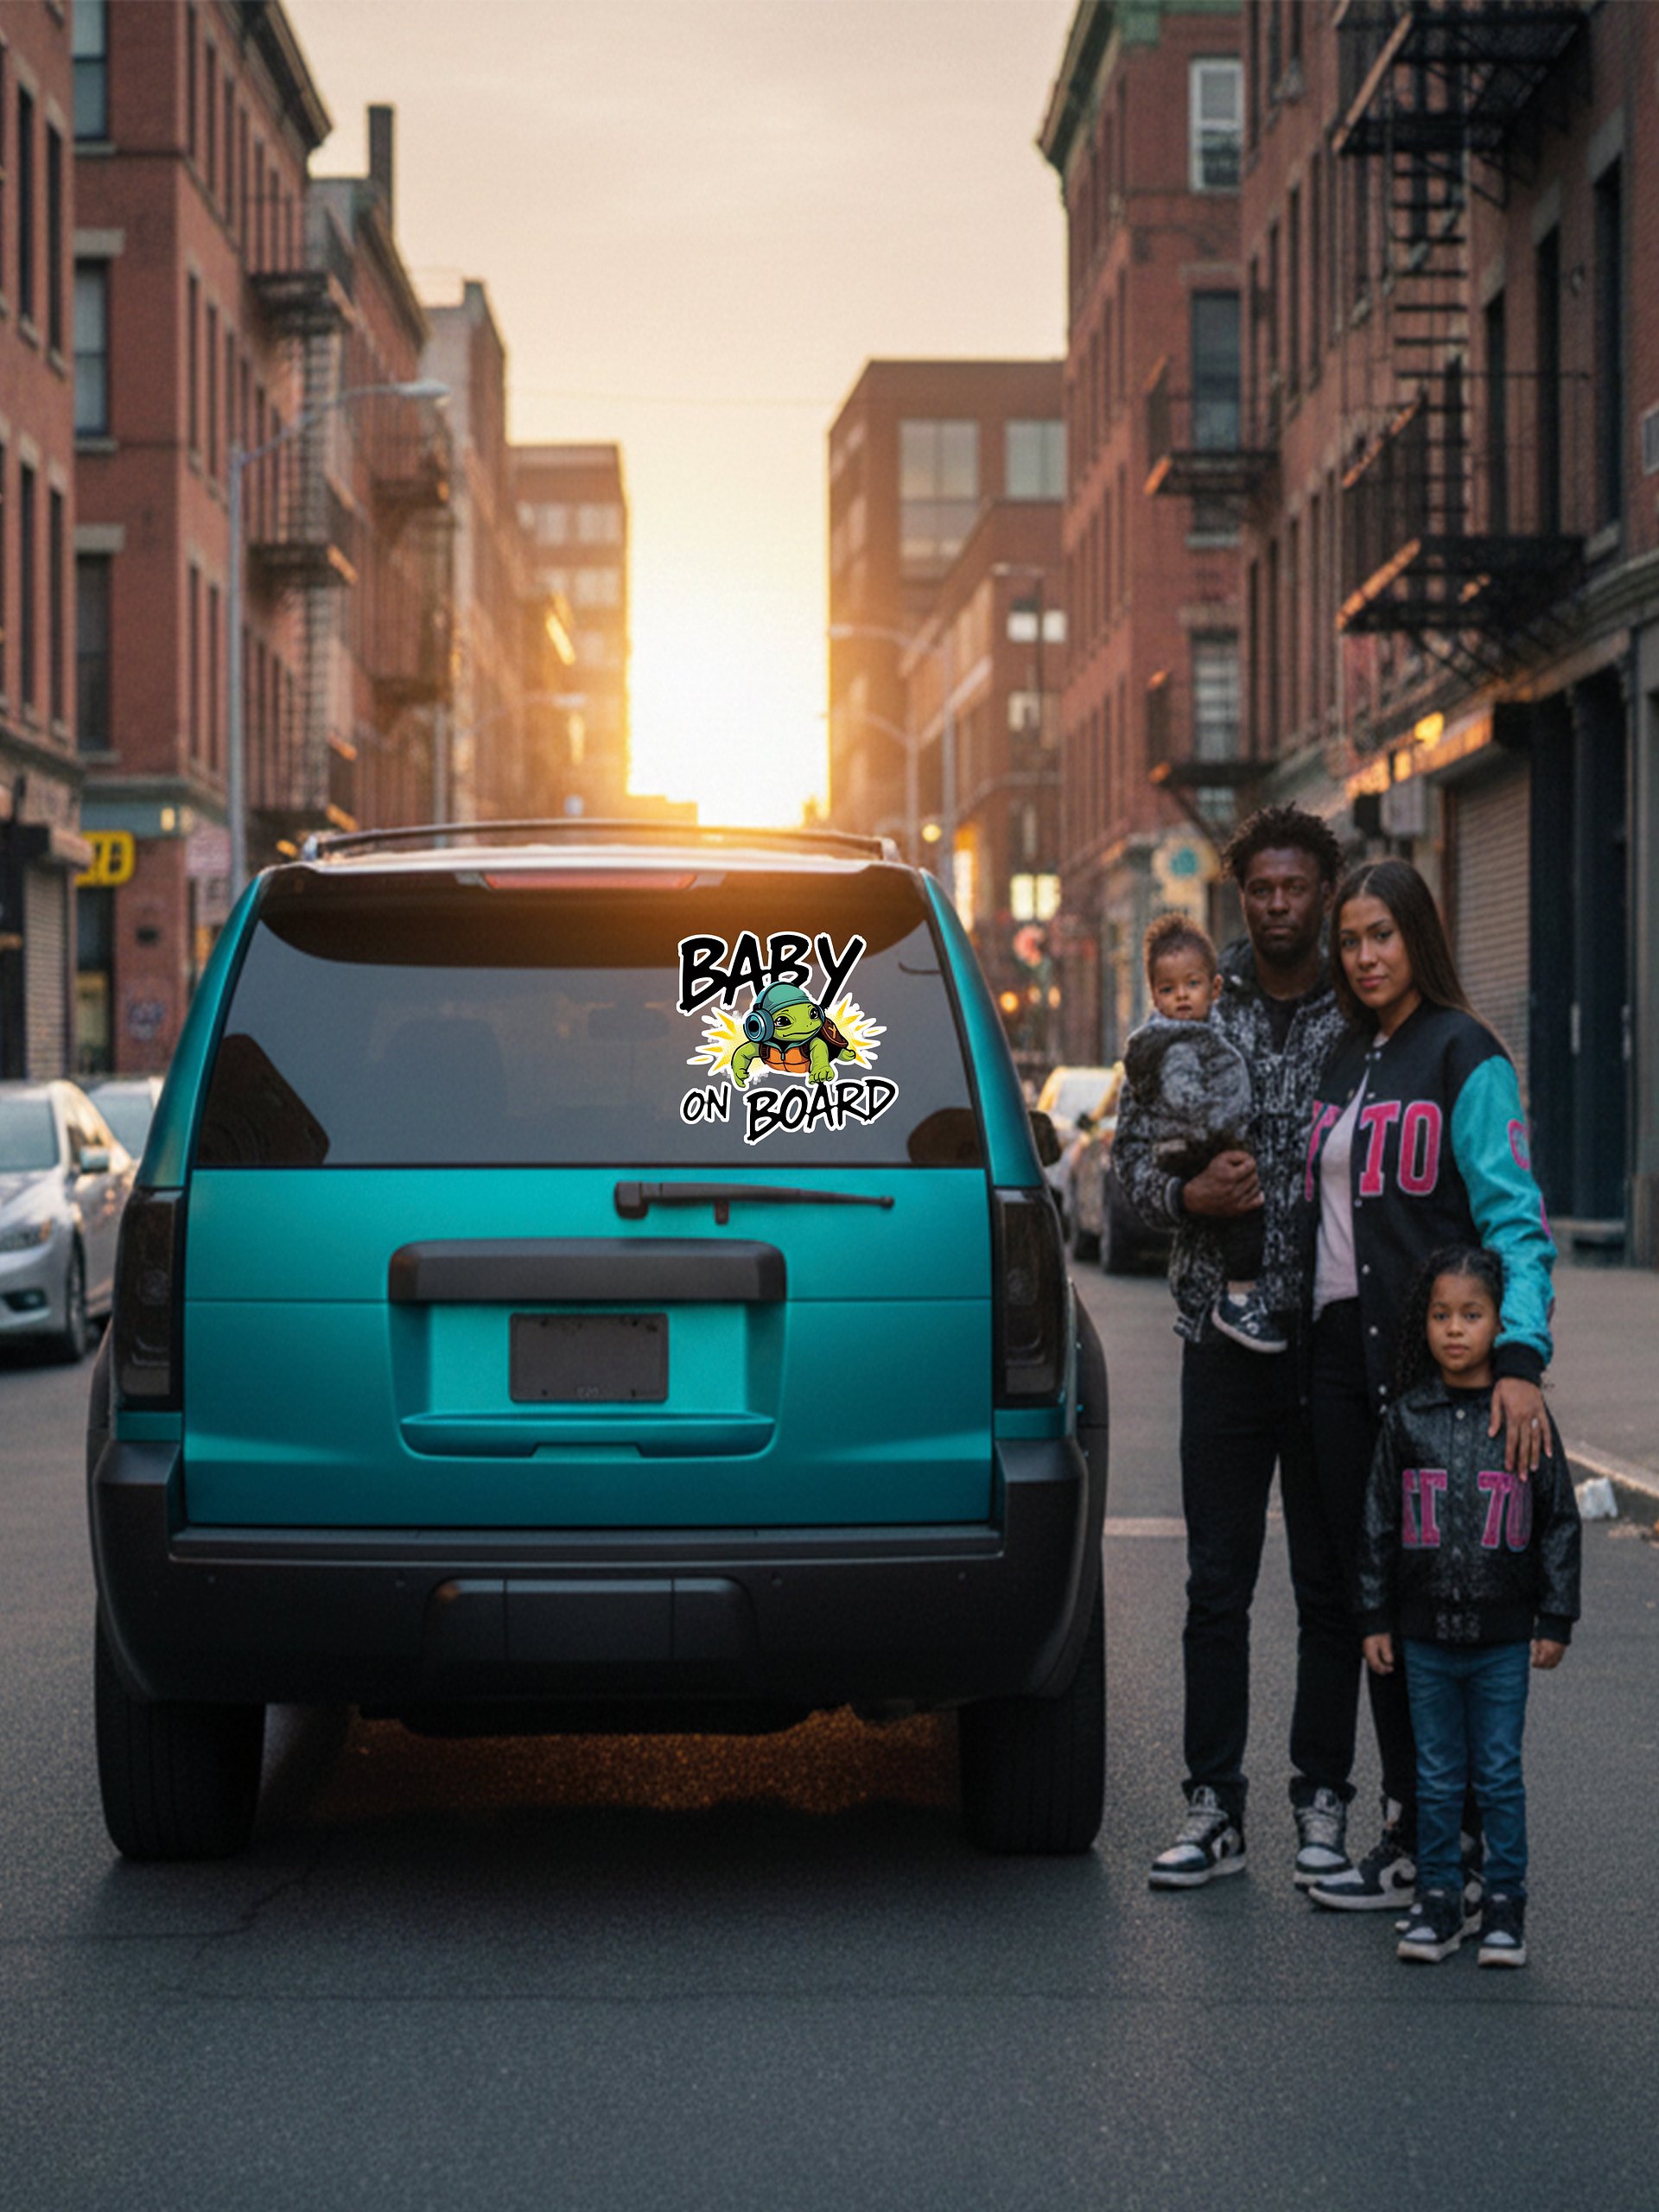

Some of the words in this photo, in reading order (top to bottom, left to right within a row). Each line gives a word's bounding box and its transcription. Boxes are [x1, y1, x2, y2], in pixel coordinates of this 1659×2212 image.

[678, 932, 865, 1014] BABY
[683, 1084, 729, 1122] ON
[746, 1078, 897, 1142] BOARD
